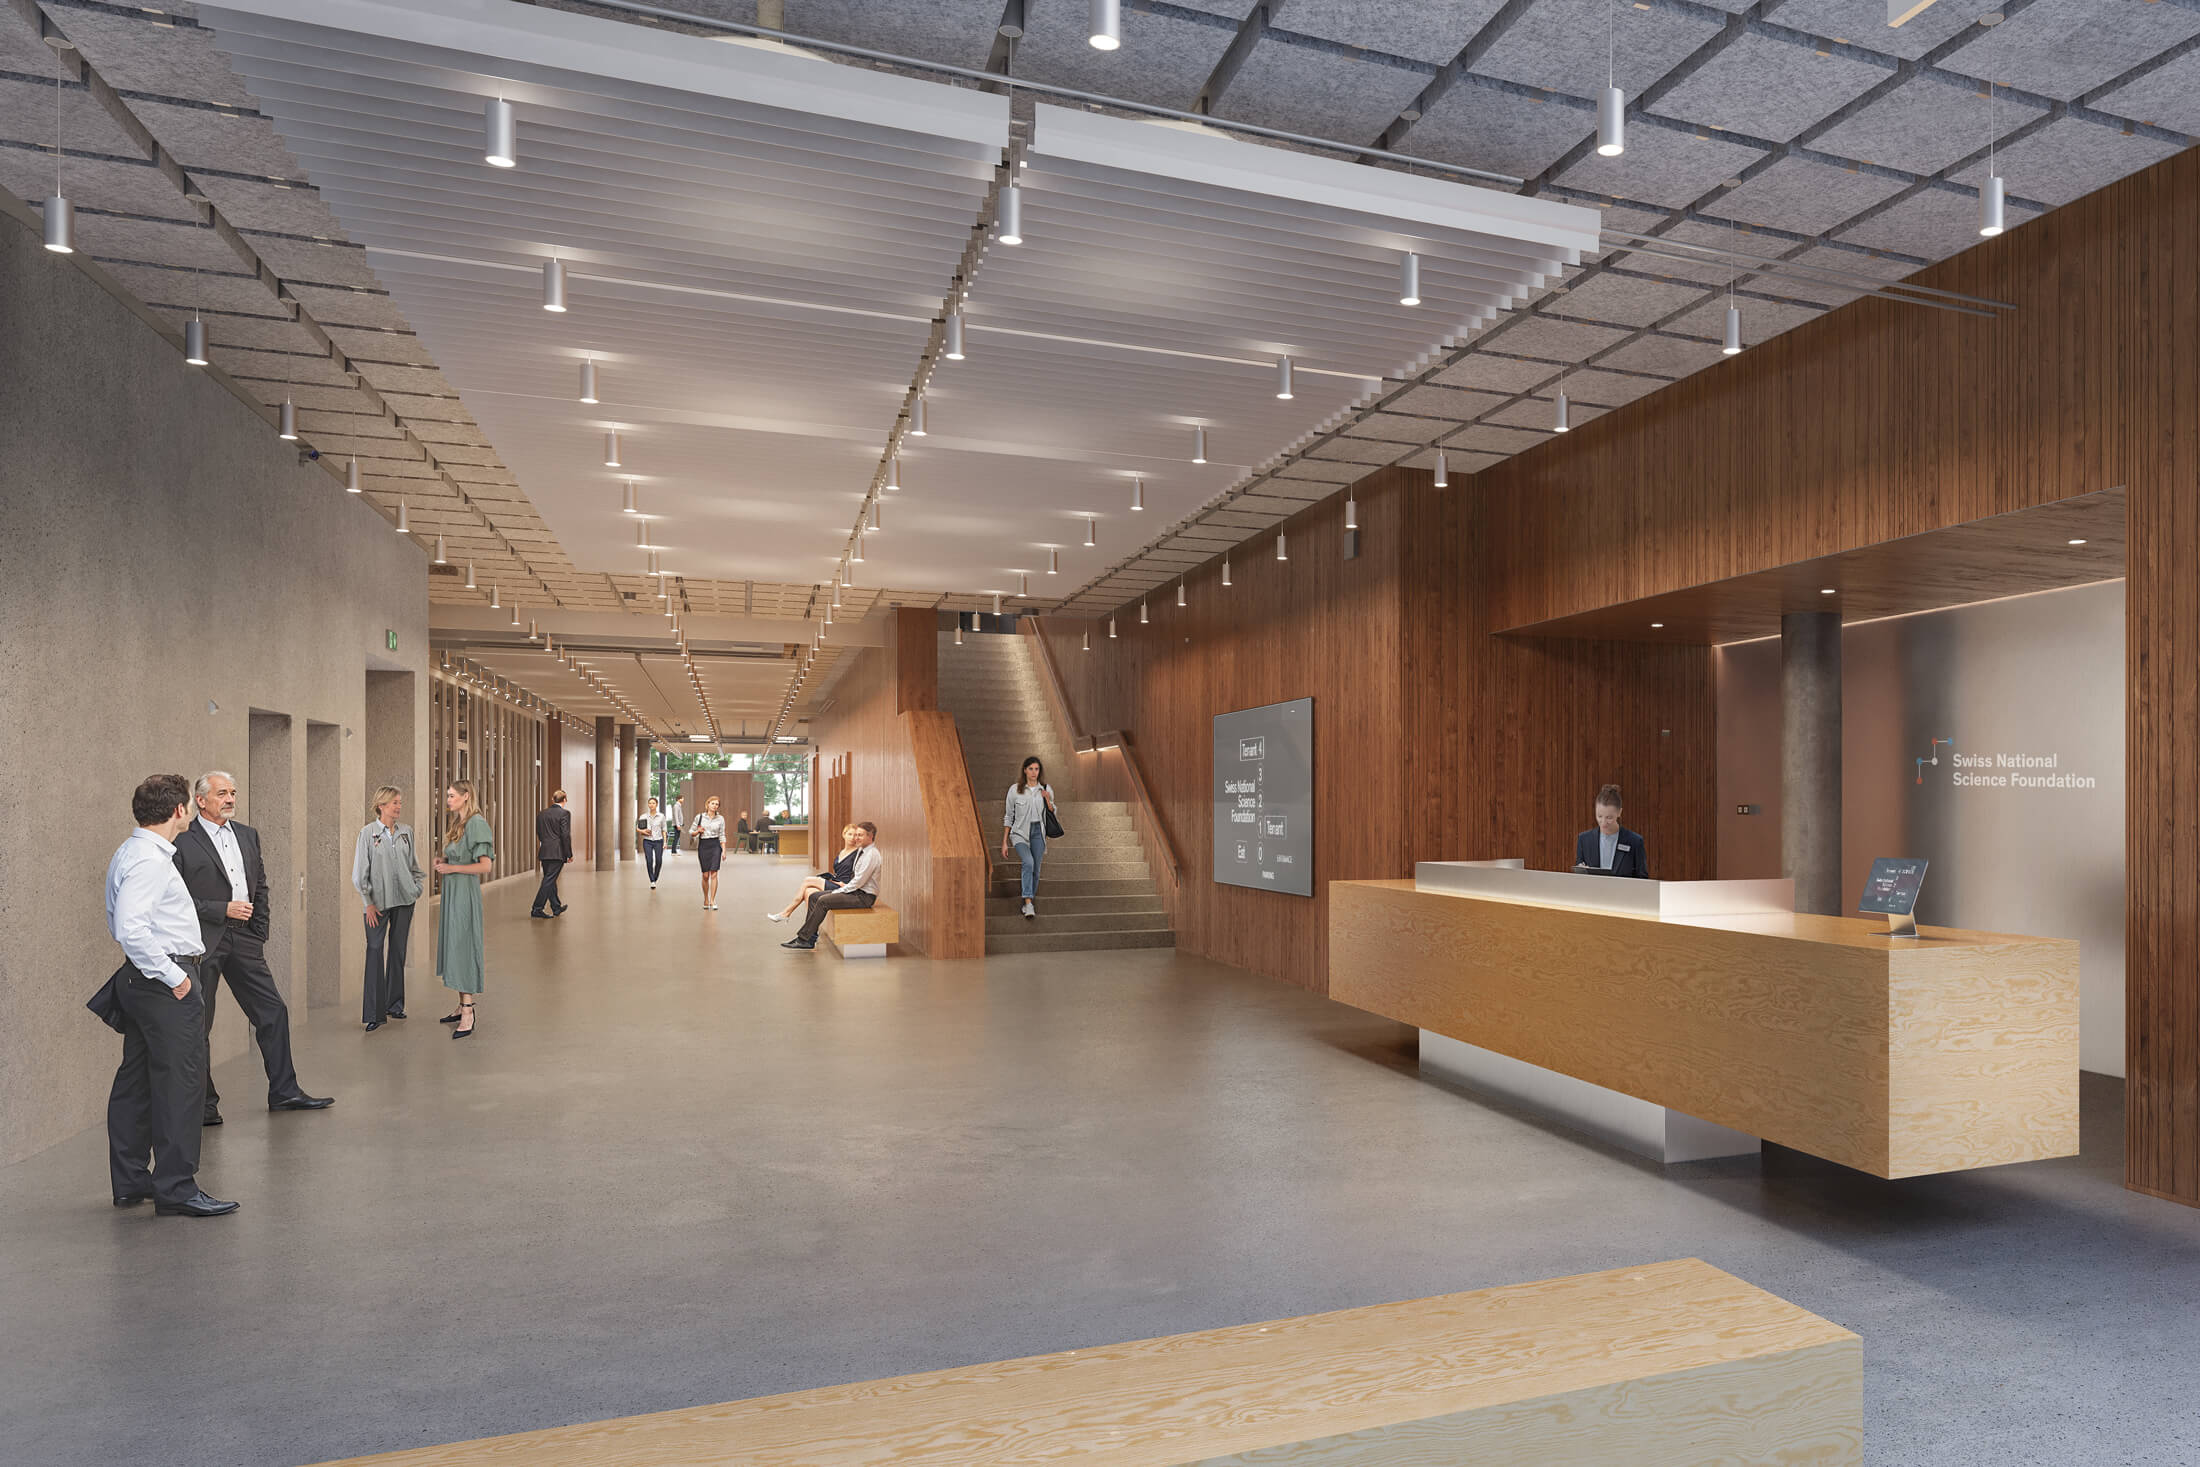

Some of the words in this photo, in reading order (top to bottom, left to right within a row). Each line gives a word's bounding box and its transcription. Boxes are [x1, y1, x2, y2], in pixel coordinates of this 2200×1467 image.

[1242, 743, 1257, 757] Tenant
[1953, 753, 1992, 768] Swiss
[1997, 753, 2057, 768] National
[1258, 767, 1263, 781] 3
[1953, 772, 2007, 787] Science
[2011, 773, 2096, 788] Foundation
[1225, 780, 1237, 793] Swiss
[1237, 779, 1255, 793] National
[1238, 794, 1255, 808] Science
[1258, 794, 1263, 808] 2
[1231, 809, 1255, 823] Foundation
[1267, 820, 1284, 835] Tenant
[1258, 846, 1263, 861] 0
